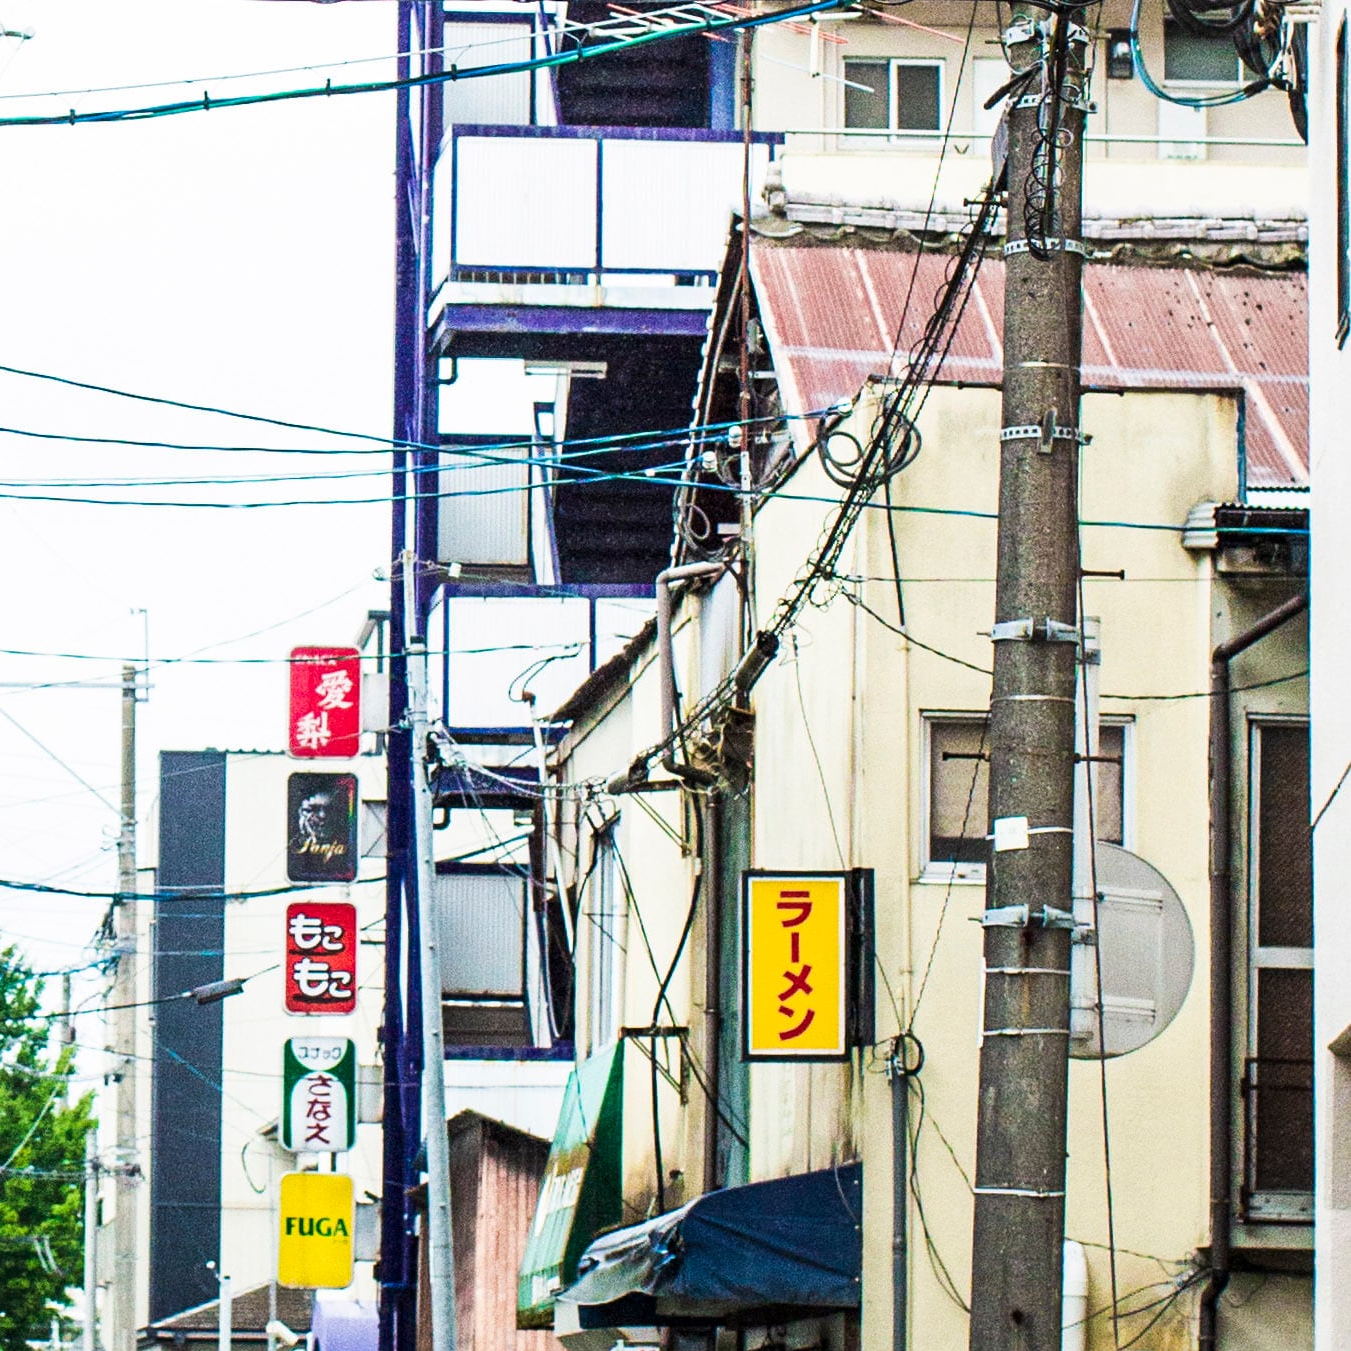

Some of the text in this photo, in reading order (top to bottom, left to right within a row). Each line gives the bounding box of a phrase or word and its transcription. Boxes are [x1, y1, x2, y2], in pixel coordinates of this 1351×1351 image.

[289, 913, 344, 951] もこ
[293, 957, 352, 998] もこ
[776, 890, 816, 1041] ラーメン
[305, 1074, 333, 1144] さなえ
[285, 1216, 349, 1237] FUGA
